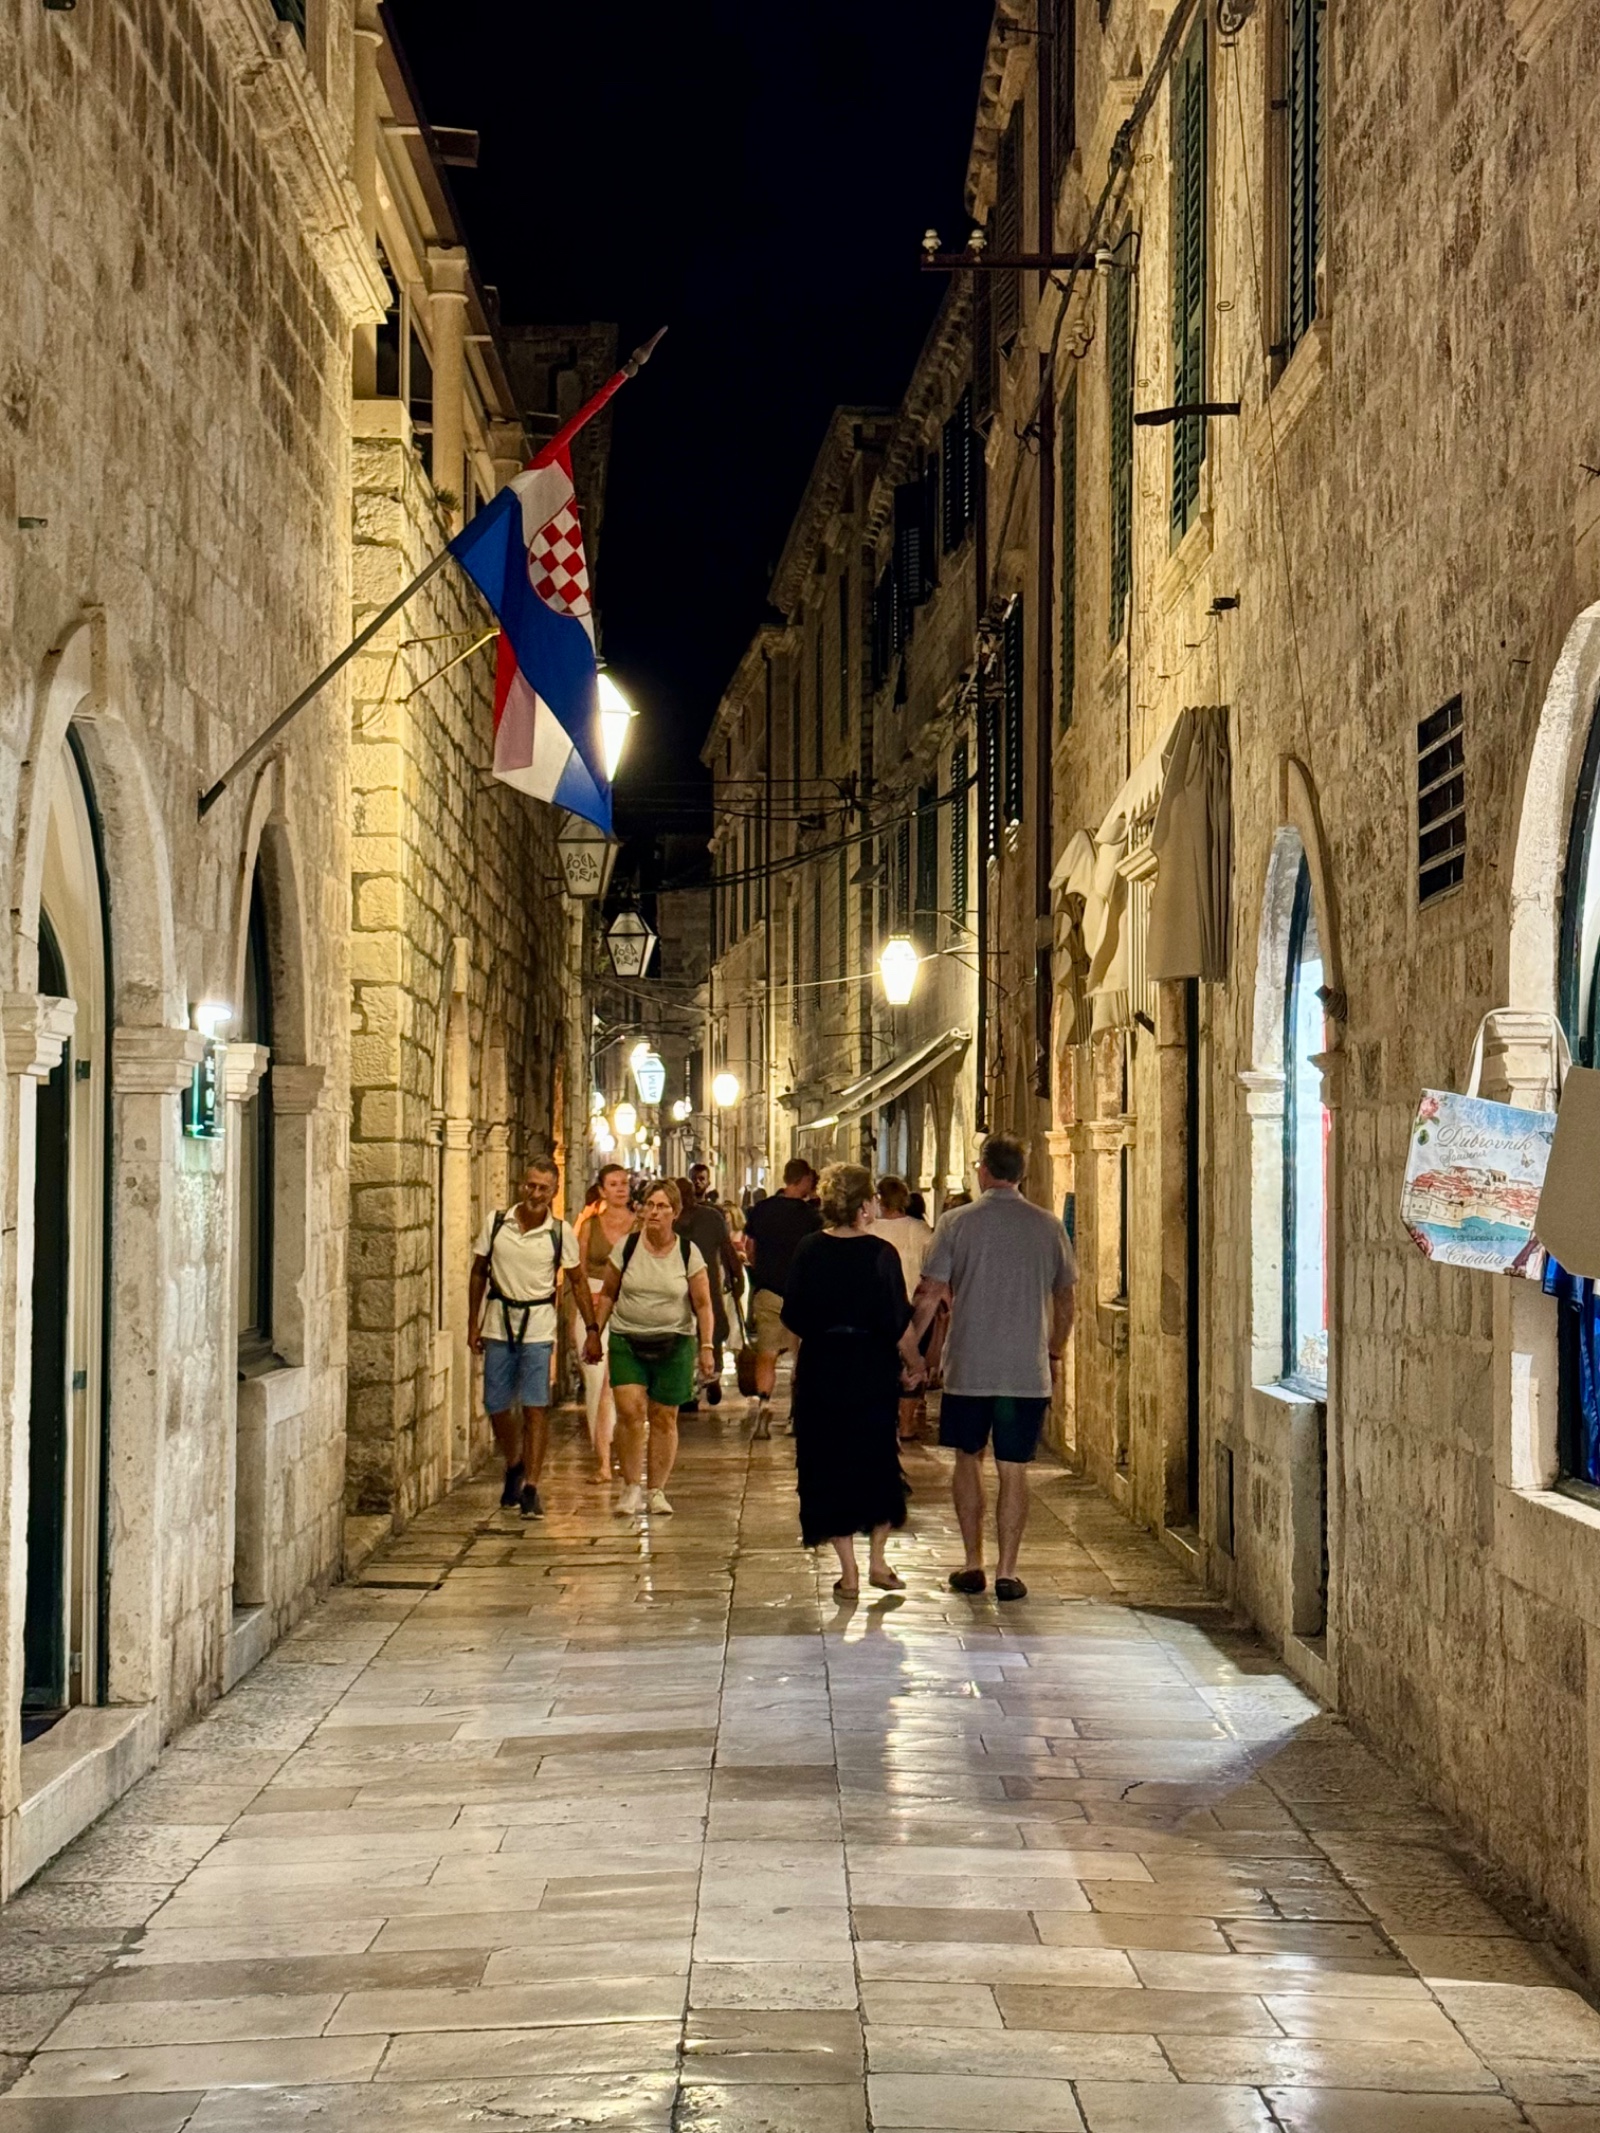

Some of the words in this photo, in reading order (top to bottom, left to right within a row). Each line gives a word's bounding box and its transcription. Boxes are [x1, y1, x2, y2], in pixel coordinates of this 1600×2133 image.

[648, 1075, 657, 1098] ATM
[1436, 1123, 1538, 1151] Dubrovnik
[1439, 1149, 1487, 1168] Souvenir
[1446, 1242, 1508, 1265] Croatia
